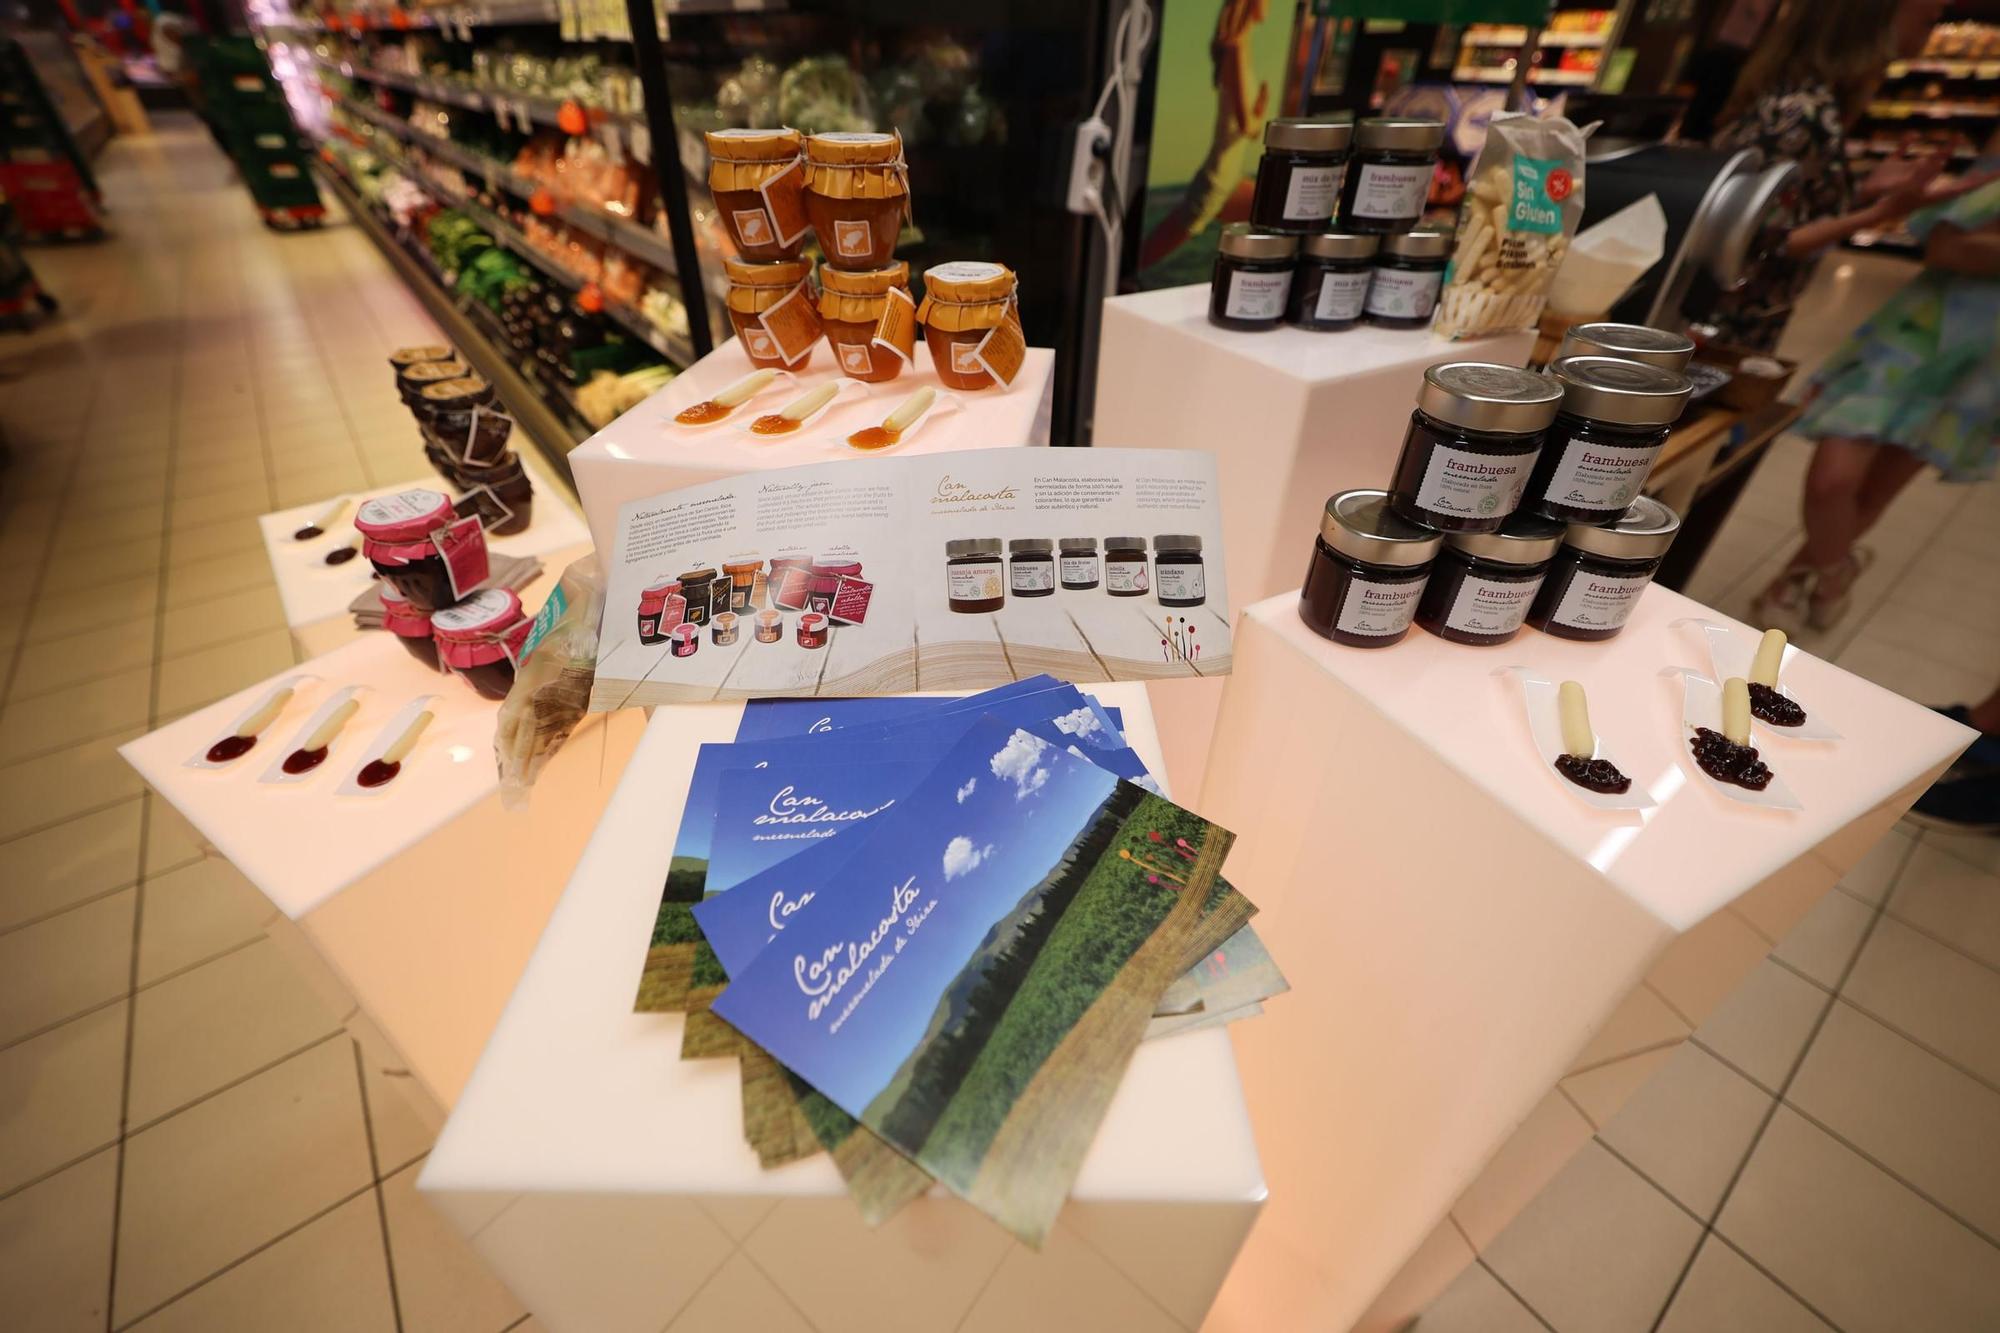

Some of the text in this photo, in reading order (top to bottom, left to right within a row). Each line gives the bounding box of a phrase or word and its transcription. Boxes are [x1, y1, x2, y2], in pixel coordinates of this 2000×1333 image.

[1517, 180, 1535, 201] Sin
[1515, 201, 1556, 225] Gluten
[1446, 458, 1517, 475] frambuesa
[1582, 452, 1650, 467] frambuesa
[930, 486, 1021, 504] malacosta
[937, 475, 968, 497] Can
[769, 785, 824, 816] Can
[808, 875, 921, 1021] malacosta
[794, 941, 845, 996] Can
[829, 954, 895, 1035] mermelada
[894, 936, 908, 954] de
